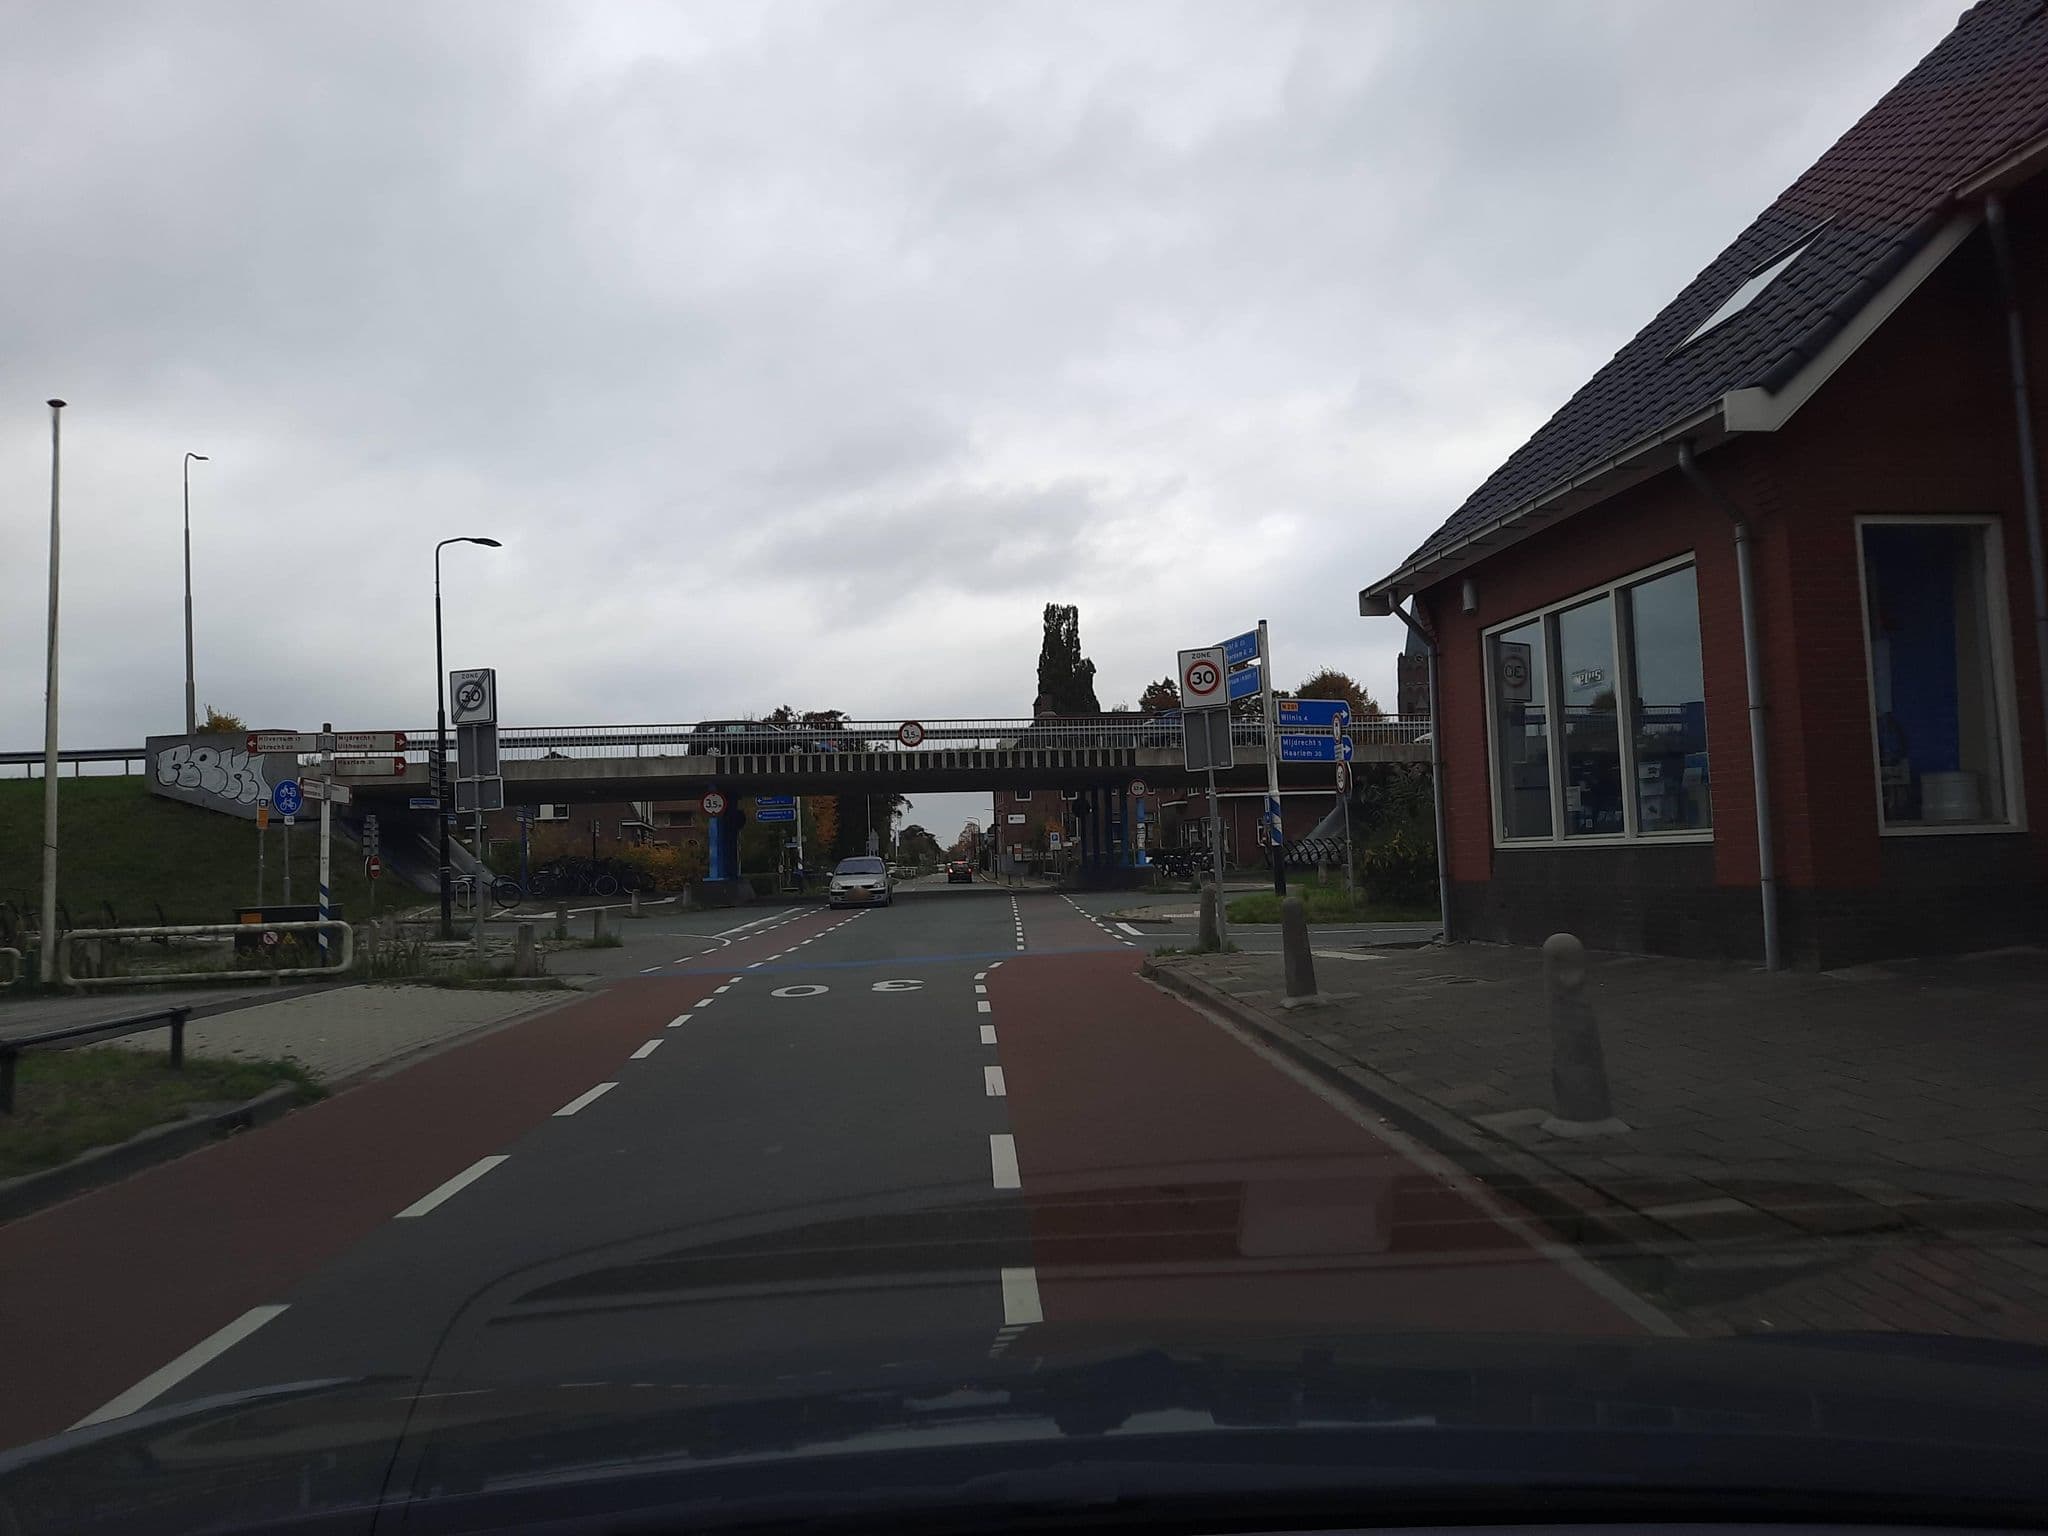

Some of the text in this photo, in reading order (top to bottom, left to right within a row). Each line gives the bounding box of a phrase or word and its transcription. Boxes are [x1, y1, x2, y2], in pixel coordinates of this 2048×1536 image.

[1191, 651, 1211, 659] ZONE
[461, 672, 479, 680] ZONE
[1192, 670, 1215, 685] 30
[461, 690, 481, 703] 30
[1280, 713, 1302, 721] Wilnis
[1282, 738, 1316, 748] Mijdrecht
[1283, 749, 1313, 757] Haarlem
